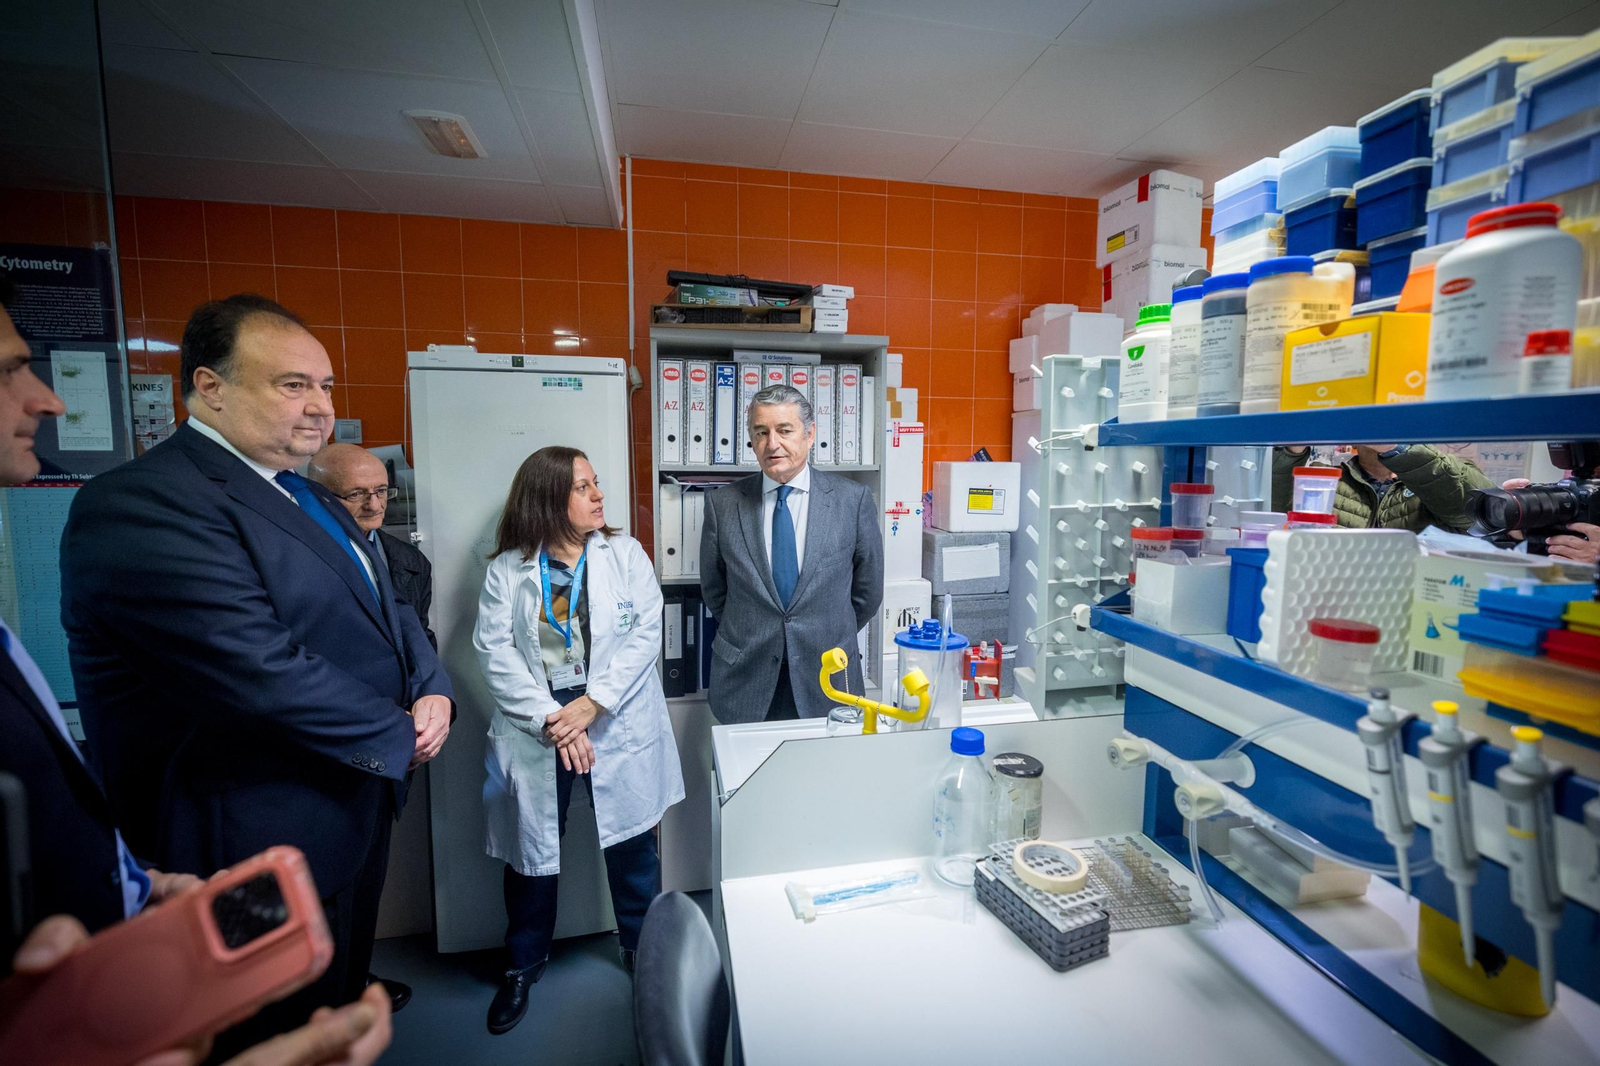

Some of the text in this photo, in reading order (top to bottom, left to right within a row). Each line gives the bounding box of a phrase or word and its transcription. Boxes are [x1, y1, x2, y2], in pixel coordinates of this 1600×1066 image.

[0, 256, 73, 274] Cytometry
[718, 377, 733, 385] A-Z
[664, 400, 678, 410] A-Z
[690, 401, 705, 411] A-Z
[817, 406, 830, 414] A-Z
[843, 406, 856, 414] A-Z
[36, 473, 63, 481] Expressed
